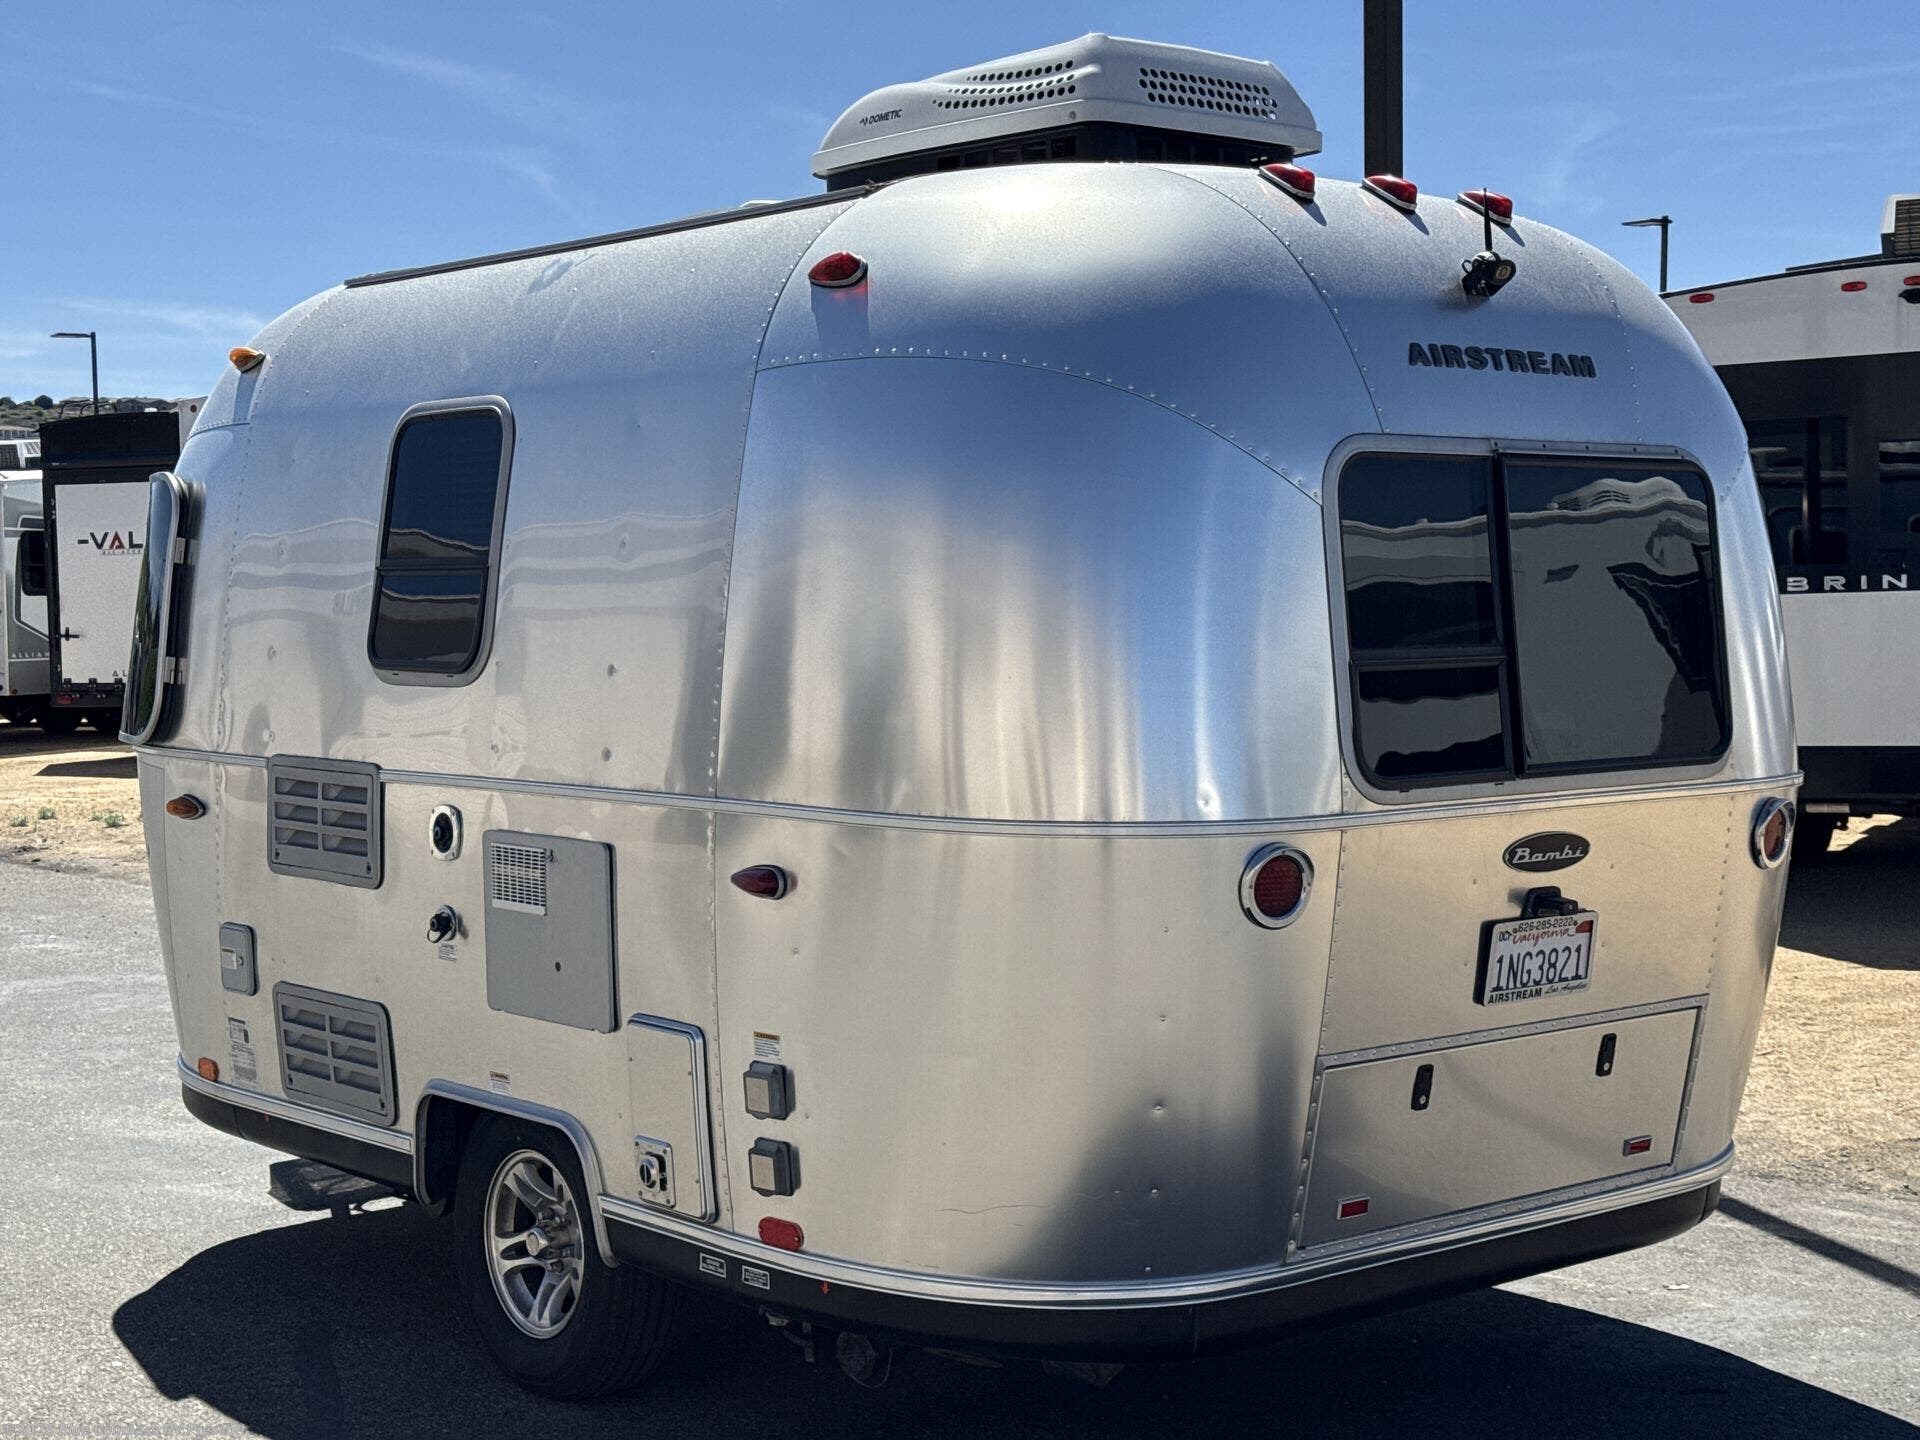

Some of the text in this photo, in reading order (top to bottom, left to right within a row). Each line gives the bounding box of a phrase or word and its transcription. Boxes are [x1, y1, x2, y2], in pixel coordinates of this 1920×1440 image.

[868, 109, 903, 125] DOMETIC
[1408, 342, 1597, 379] AIRSTREAM
[1512, 844, 1586, 864] Bambi
[1490, 944, 1583, 993] 1NG3821
[1487, 987, 1543, 1004] AIRSTREAM
